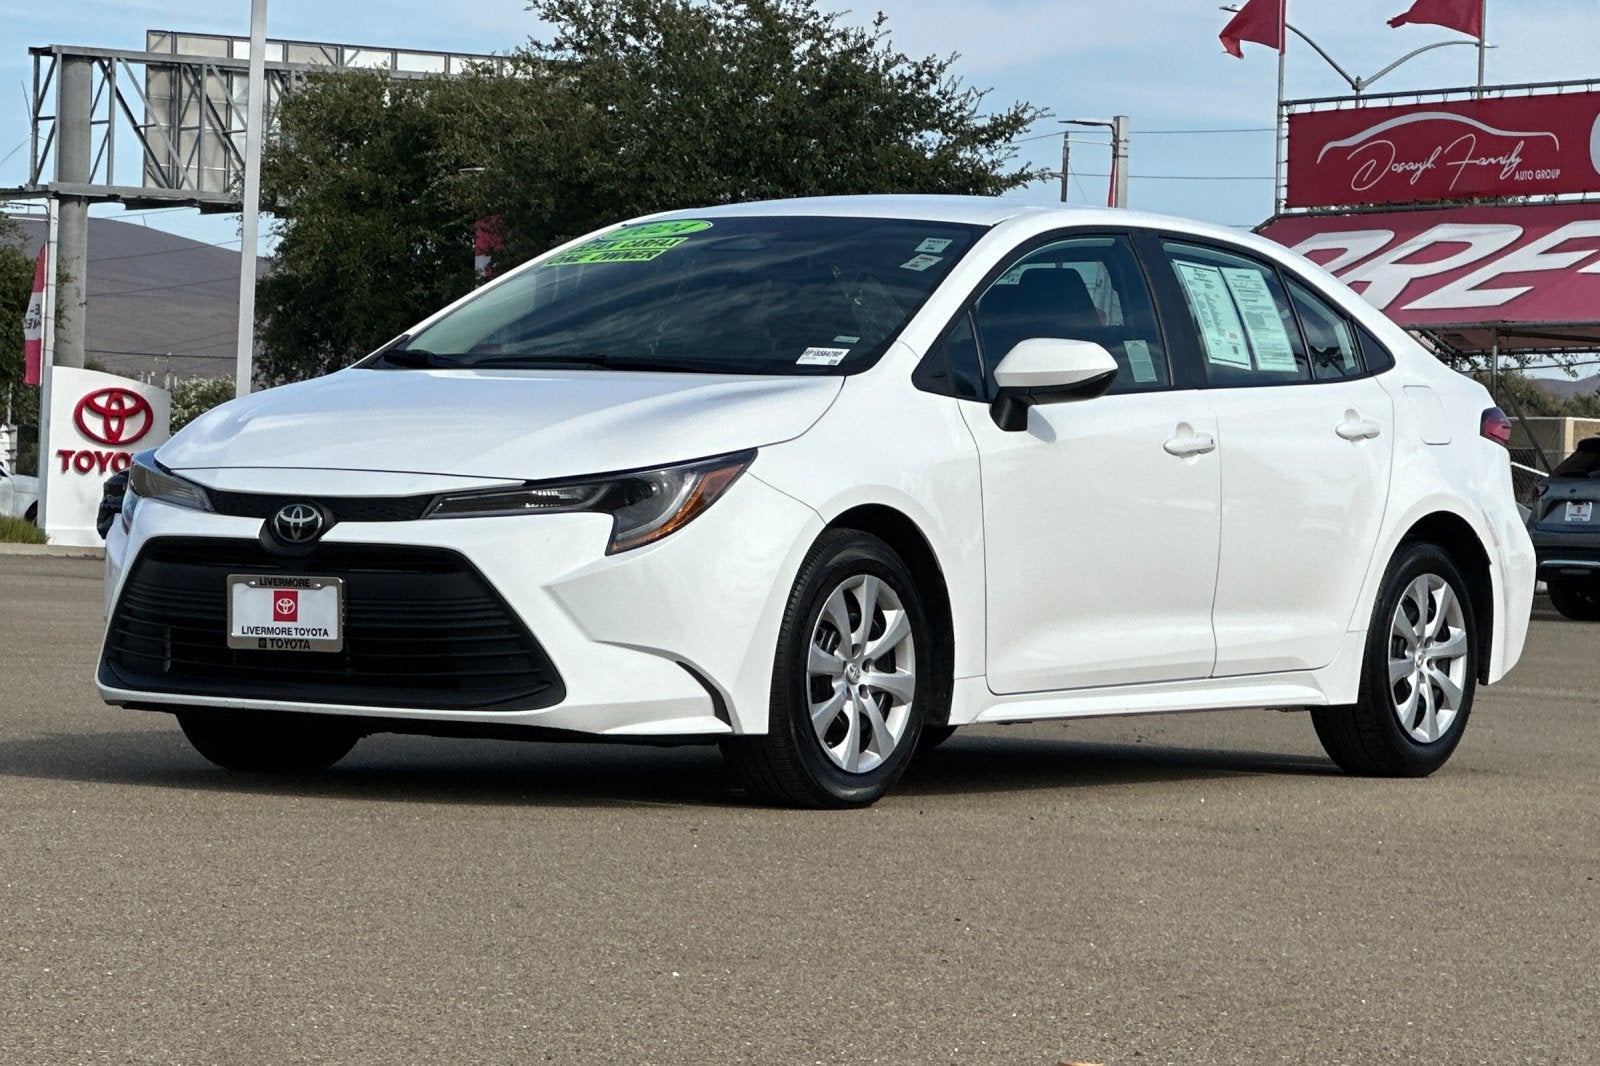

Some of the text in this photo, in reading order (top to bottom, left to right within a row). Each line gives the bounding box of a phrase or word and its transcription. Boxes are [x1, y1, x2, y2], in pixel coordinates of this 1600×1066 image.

[1444, 133, 1525, 192] Family
[1514, 168, 1561, 181] AUTO GROUP
[1287, 218, 1600, 311] PRE
[57, 449, 134, 473] TOYO
[259, 577, 310, 588] LIVERMORE
[241, 625, 329, 637] LIVERMORE TOYOTA
[270, 638, 311, 650] TOYOTA
